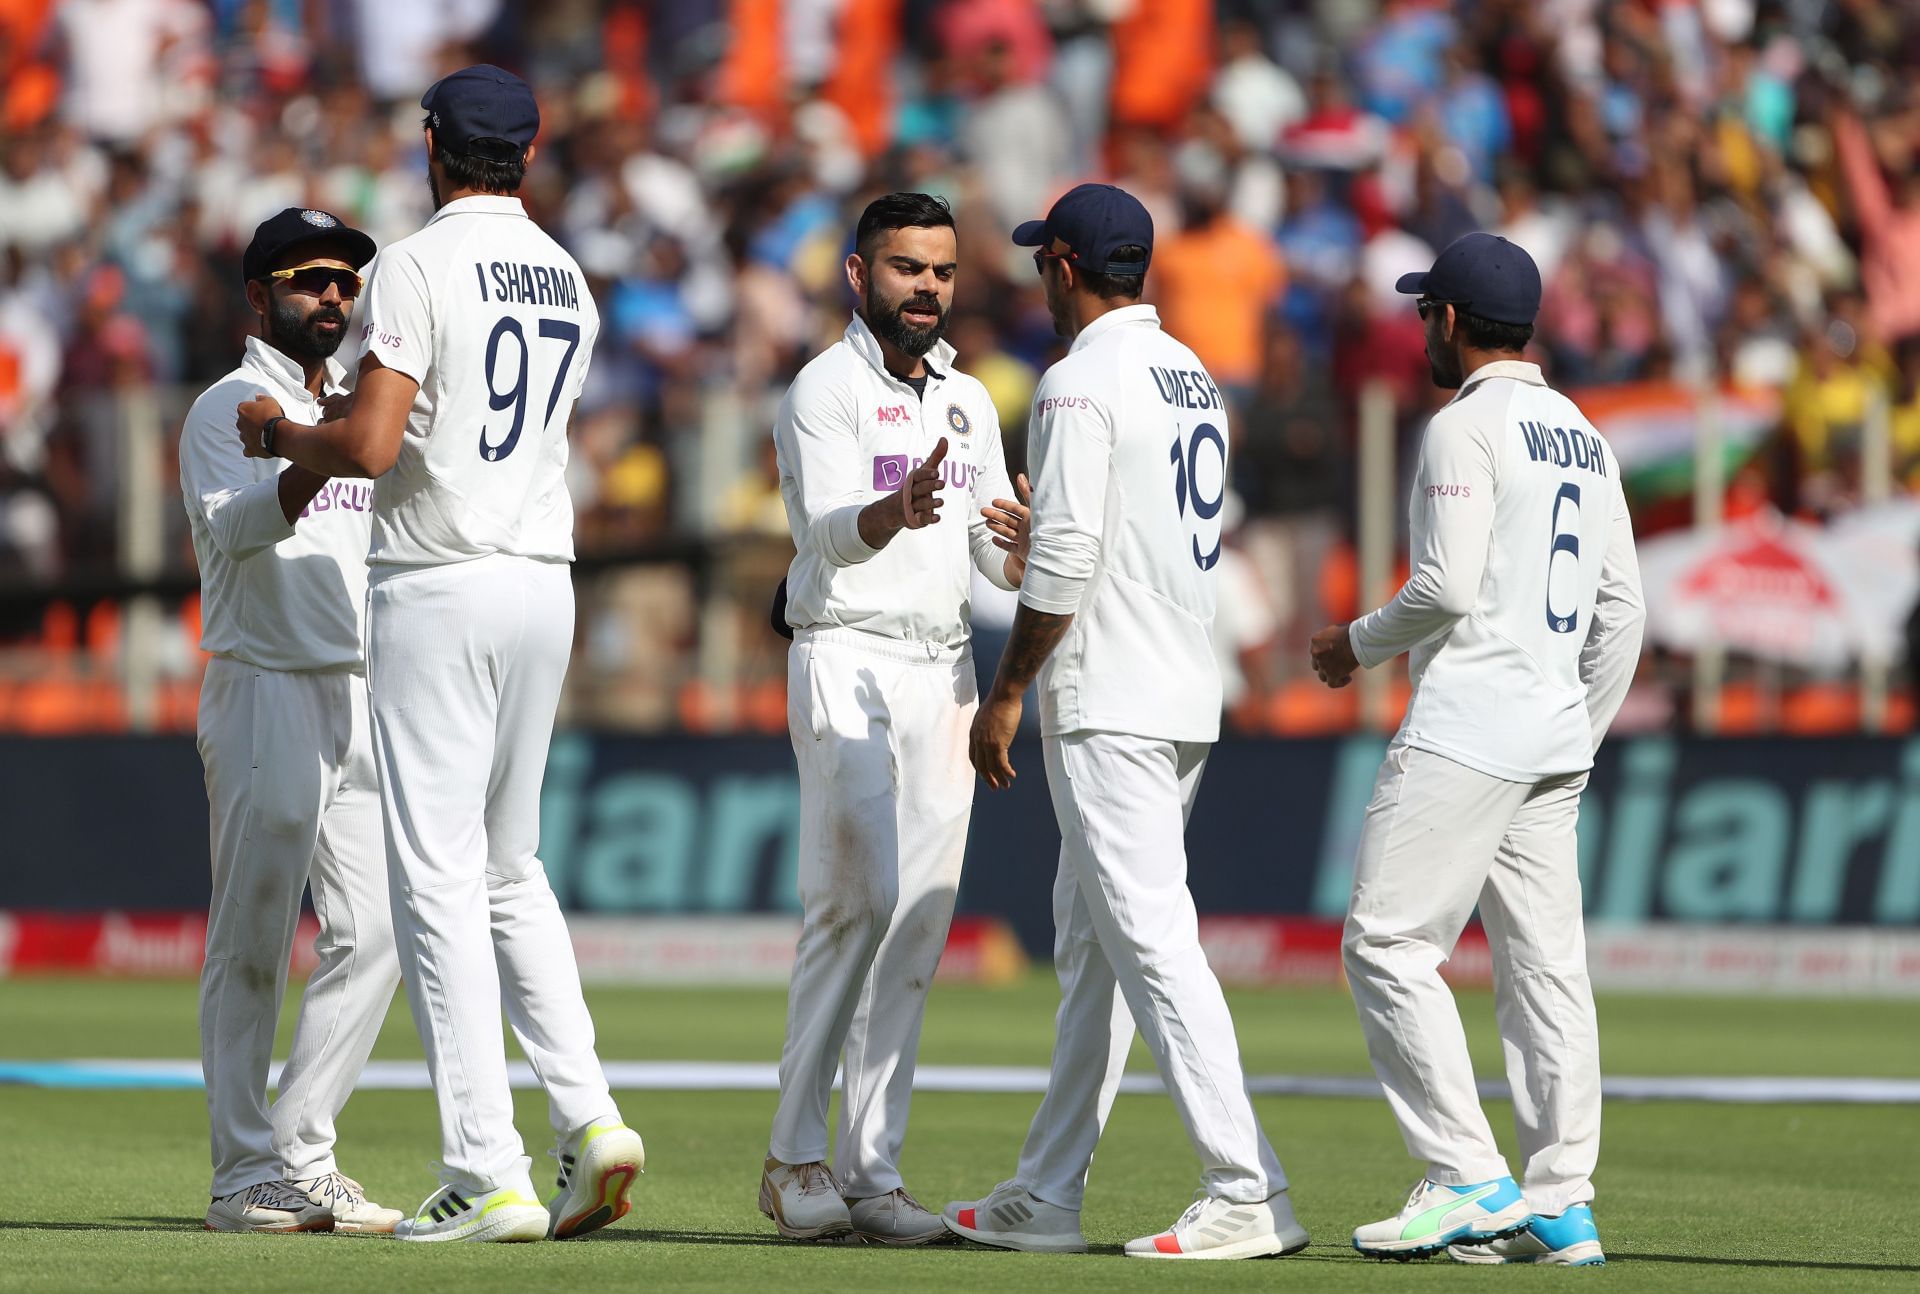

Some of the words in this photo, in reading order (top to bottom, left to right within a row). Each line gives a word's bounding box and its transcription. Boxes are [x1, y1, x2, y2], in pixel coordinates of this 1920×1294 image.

[475, 262, 488, 302] I
[490, 261, 579, 312] SHARMA
[479, 315, 580, 462] 97
[1045, 396, 1088, 411] BYJU'S
[1149, 366, 1225, 411] UMESH
[912, 458, 977, 493] JU'S
[1170, 422, 1225, 571] 19
[1429, 485, 1471, 498] BYJU'S
[1546, 482, 1581, 633] 6
